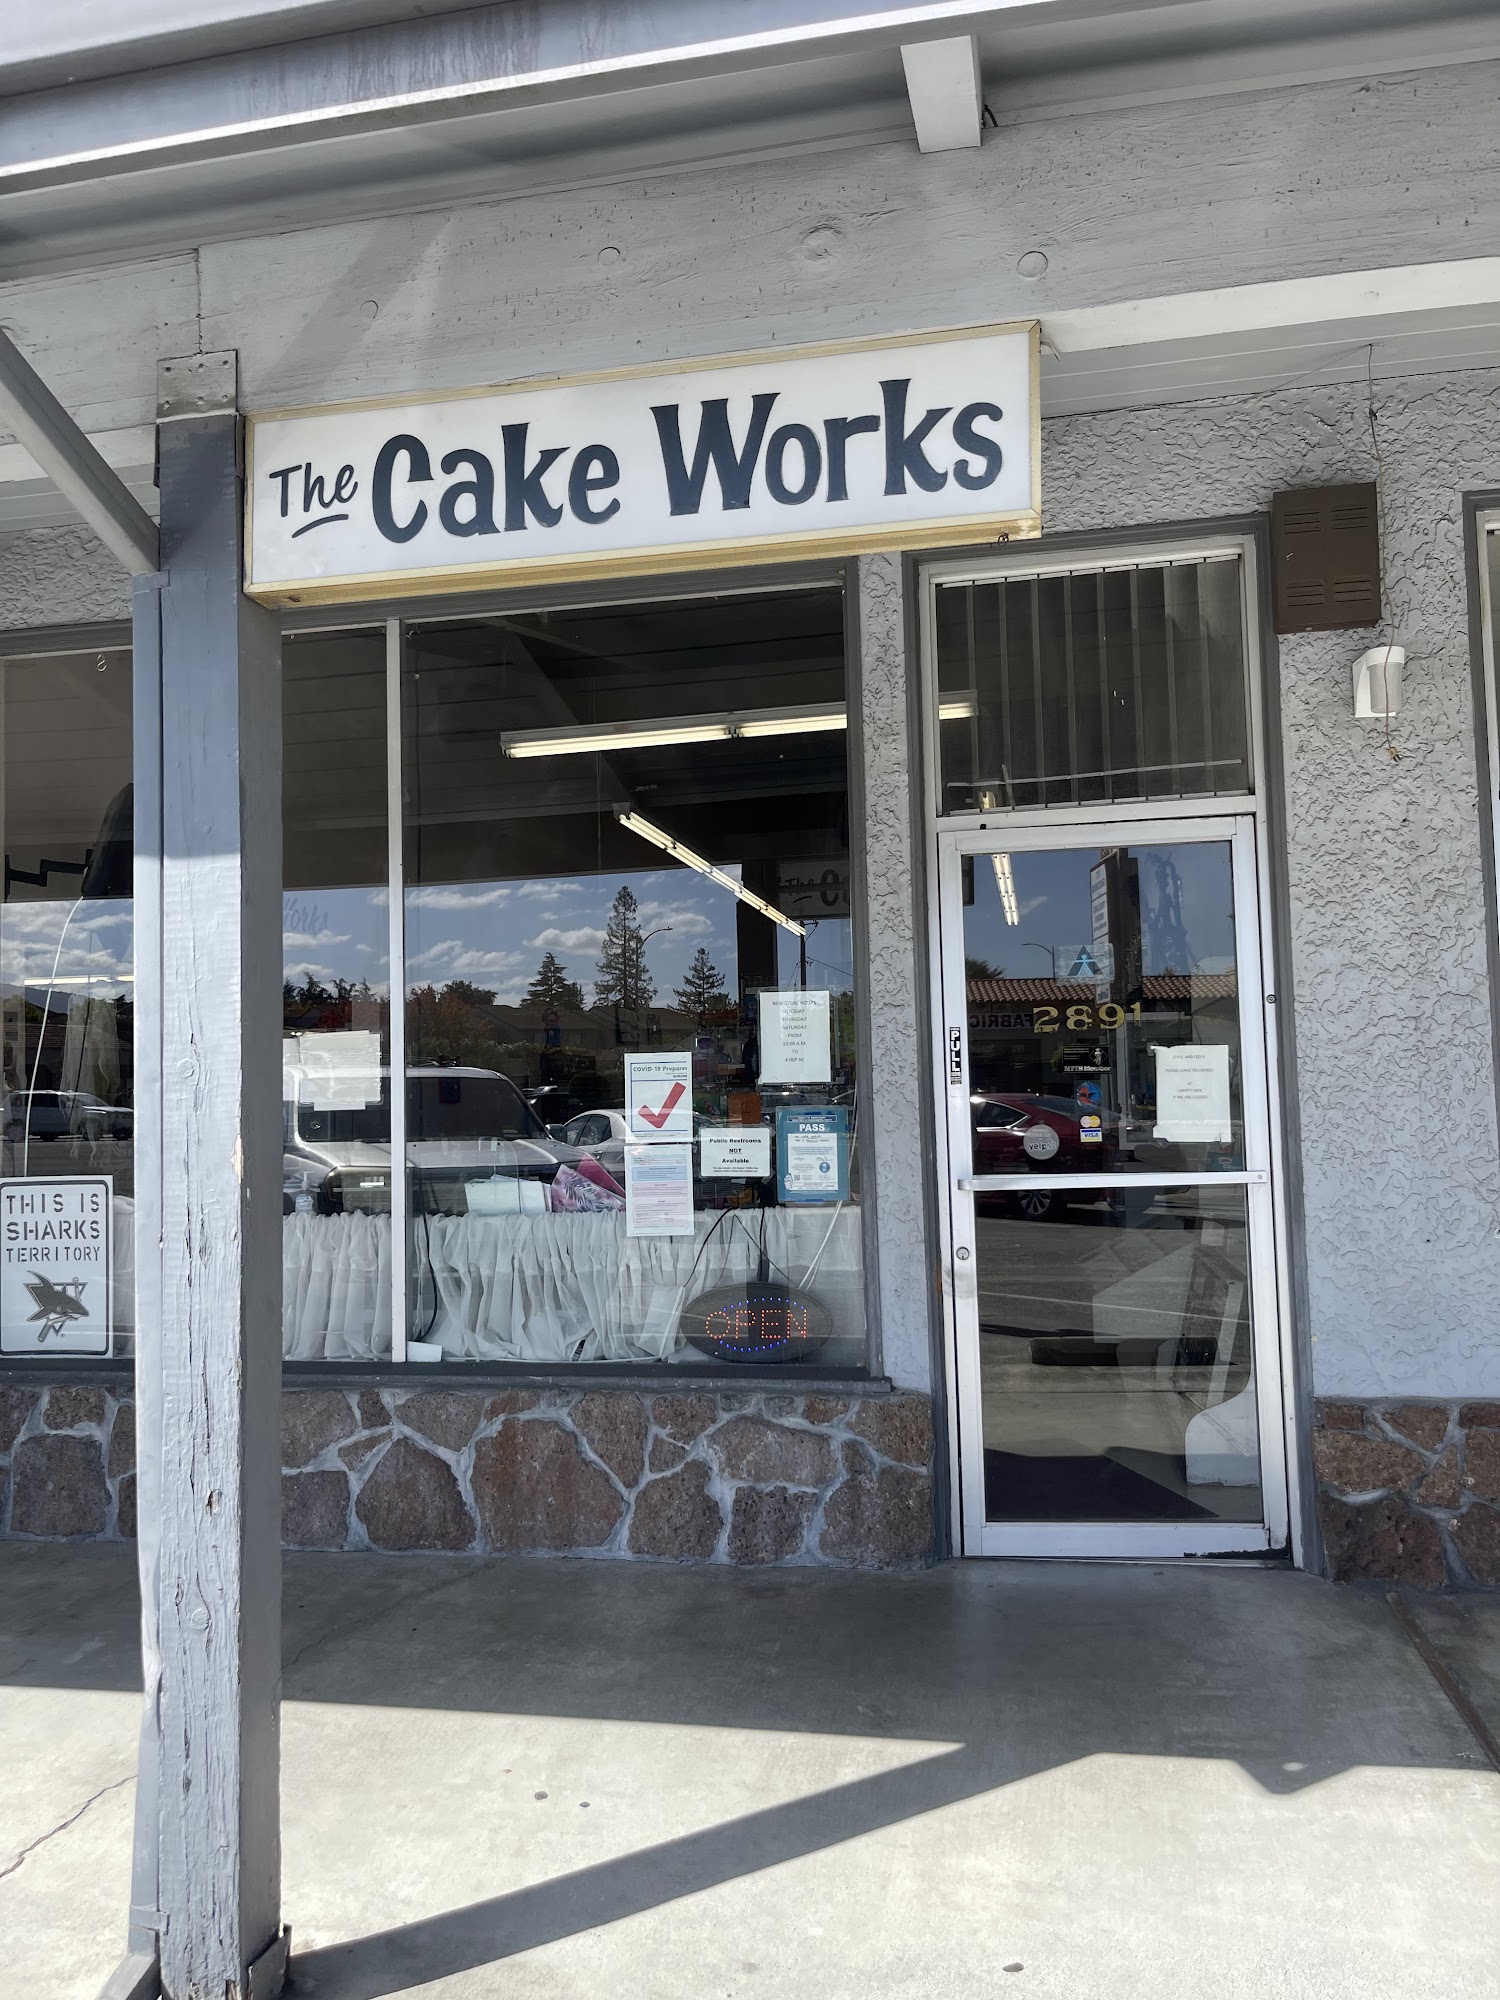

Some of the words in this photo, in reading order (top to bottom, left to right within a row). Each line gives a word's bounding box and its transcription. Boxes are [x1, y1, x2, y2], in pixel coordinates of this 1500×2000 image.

[269, 461, 358, 518] The
[371, 421, 621, 544] Cake
[649, 378, 1005, 516] Works
[1032, 1001, 1142, 1033] 2891
[950, 1030, 961, 1072] PULL
[798, 1123, 826, 1132] PASS
[1028, 1142, 1047, 1152] yelp
[6, 1193, 64, 1214] THIS
[80, 1193, 100, 1213] IS
[6, 1220, 100, 1241] SHARKS
[6, 1246, 100, 1262] TERRITORY
[705, 1308, 808, 1340] OPEN
